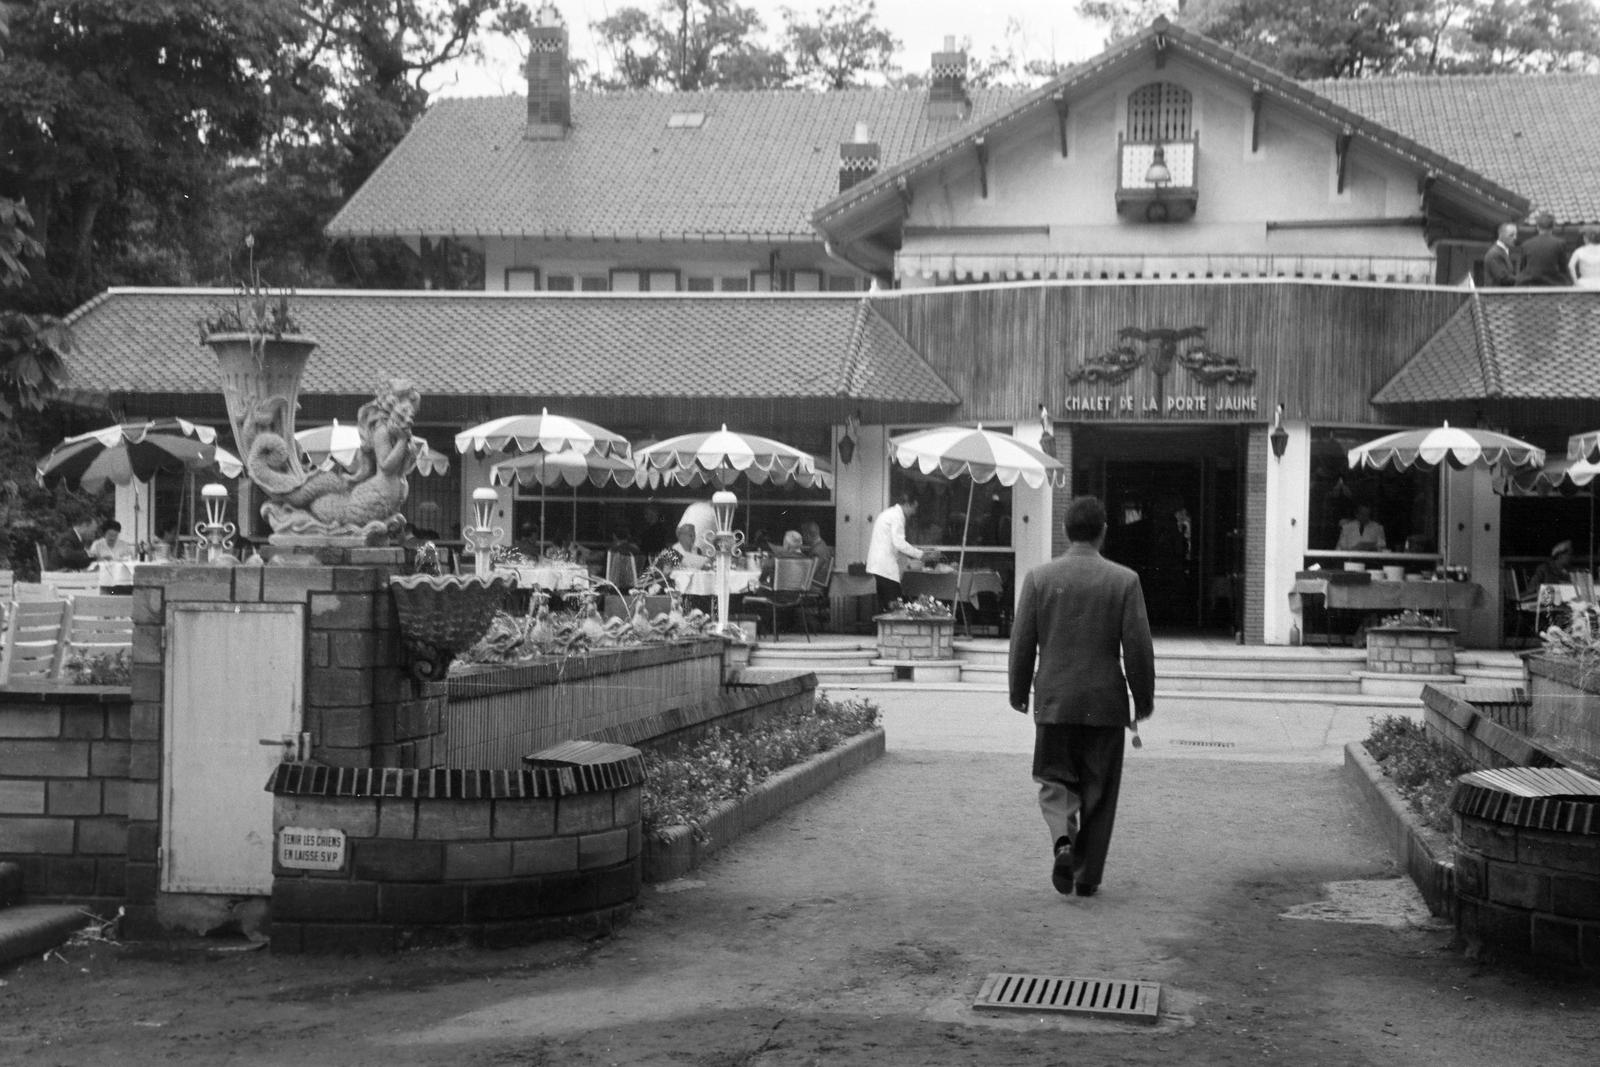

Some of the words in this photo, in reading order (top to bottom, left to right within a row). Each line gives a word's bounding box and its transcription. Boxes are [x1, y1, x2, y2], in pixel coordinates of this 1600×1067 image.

[1065, 395, 1111, 411] CHALET
[1120, 395, 1134, 411] DE
[1142, 396, 1158, 411] LA
[1167, 396, 1206, 411] PORTE
[1216, 396, 1258, 411] JAUNE
[284, 833, 301, 845] TENIR
[303, 835, 315, 846] LES
[316, 836, 341, 848] CHIENS
[284, 849, 293, 860] EN
[294, 850, 318, 862] LAISSE
